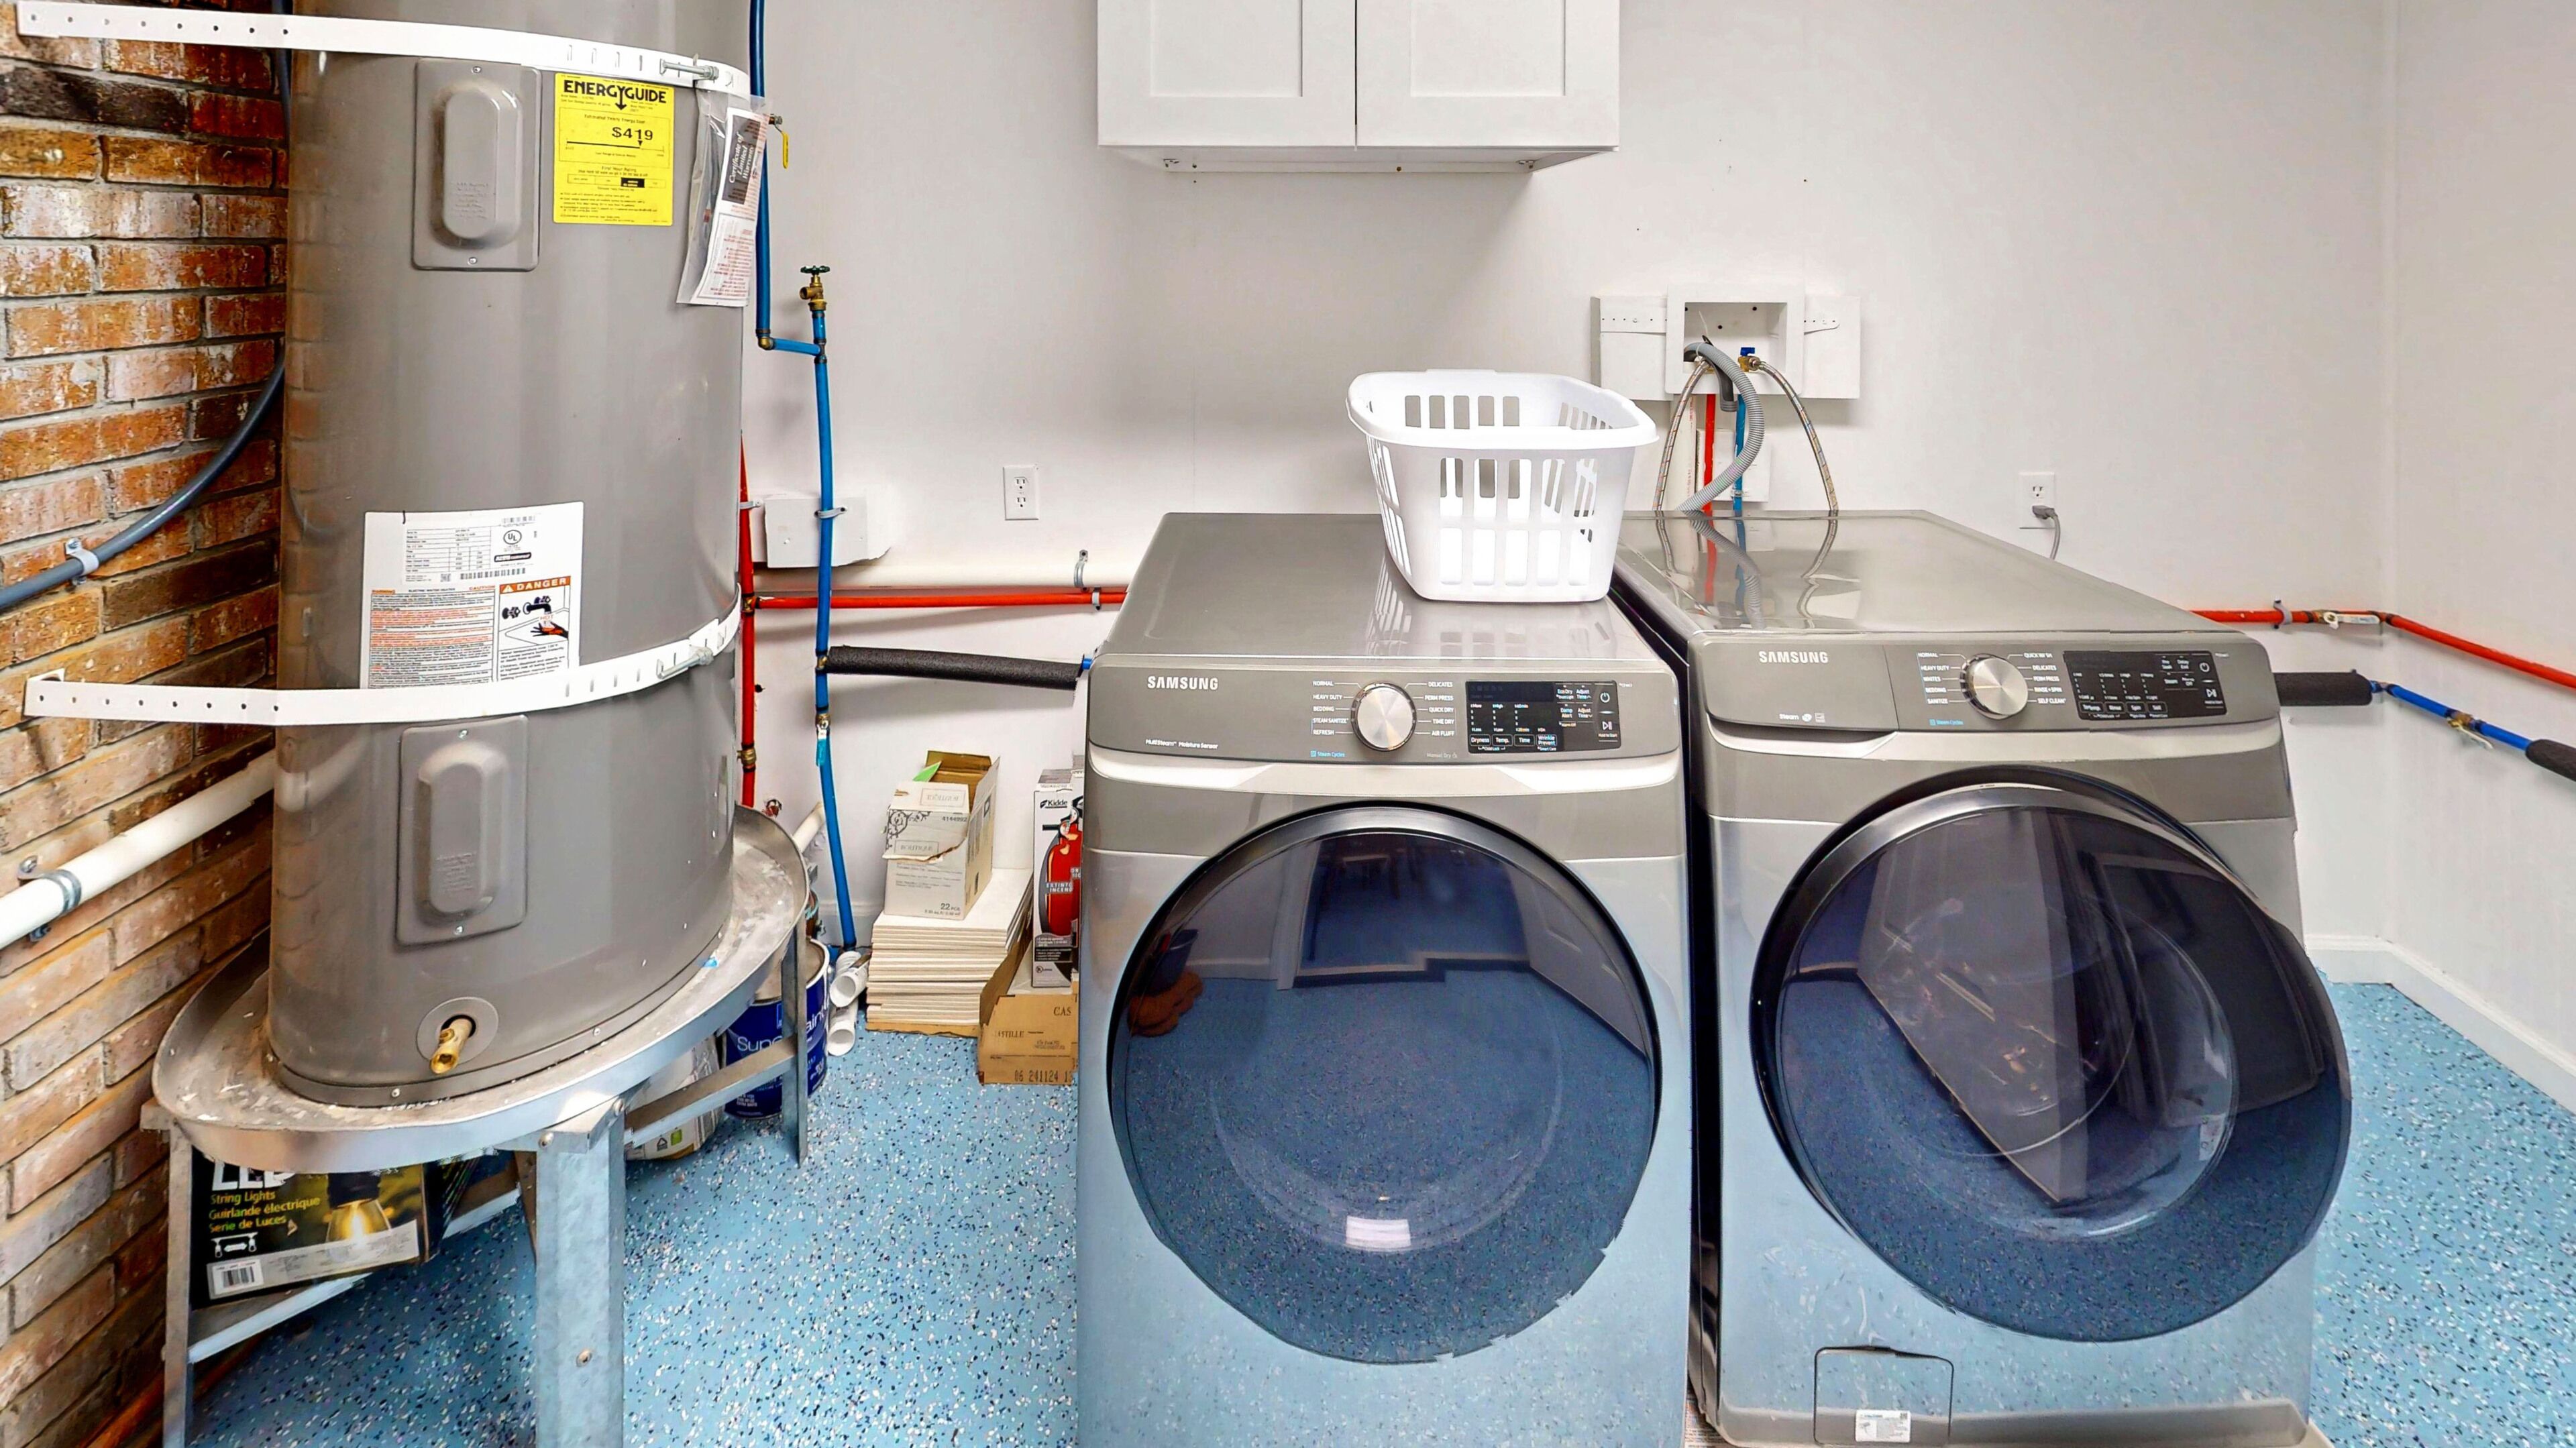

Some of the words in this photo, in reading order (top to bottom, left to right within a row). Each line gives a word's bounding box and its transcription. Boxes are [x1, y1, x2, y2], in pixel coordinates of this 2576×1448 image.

[564, 80, 666, 103] ENERGYGUIDE
[612, 127, 653, 140] $419
[729, 144, 741, 183] Certificate
[508, 533, 517, 541] UL
[517, 577, 566, 590] DANGER
[1758, 651, 1829, 663] SAMSUNG
[1147, 675, 1218, 690] SAMSUNG
[941, 903, 951, 911] 22
[1053, 1007, 1071, 1016] CAS
[1014, 1070, 1024, 1082] 06
[1028, 1070, 1059, 1082] 241124
[210, 1194, 241, 1206] String
[244, 1190, 276, 1204] Lights
[209, 1205, 261, 1220] Guirlande
[264, 1196, 321, 1213] électrique
[209, 1222, 235, 1233] Serie
[239, 1219, 254, 1229] de
[256, 1215, 287, 1227] Luces
